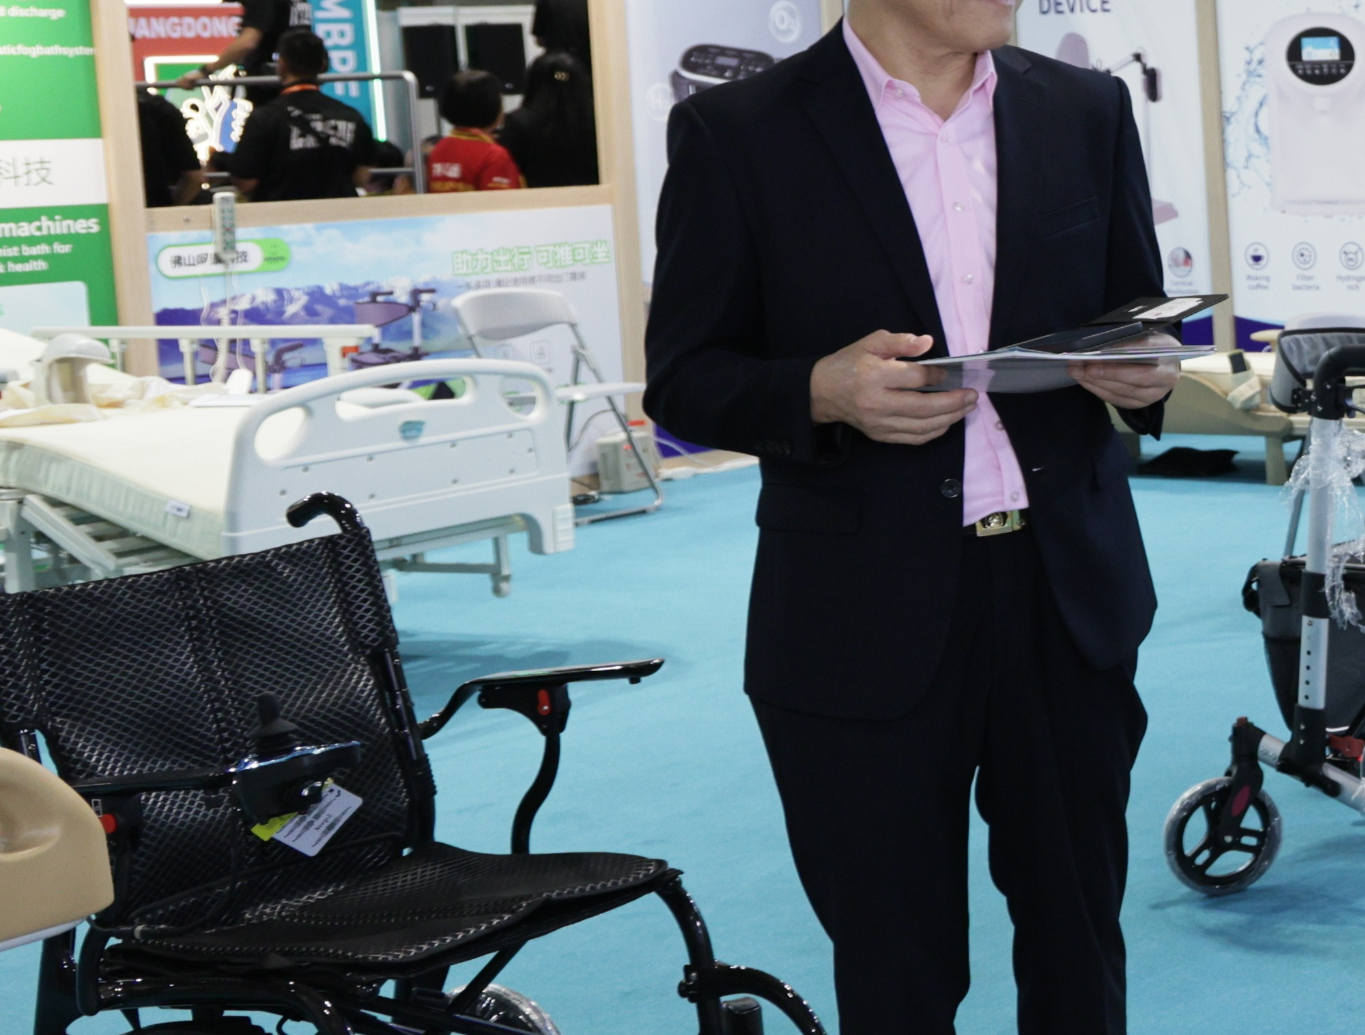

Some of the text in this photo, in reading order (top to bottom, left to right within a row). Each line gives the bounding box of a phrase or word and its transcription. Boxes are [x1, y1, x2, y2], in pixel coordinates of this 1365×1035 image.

[8, 6, 66, 20] discharge
[0, 215, 101, 238] machines
[21, 243, 50, 256] bath
[53, 242, 73, 254] for
[8, 259, 49, 273] health
